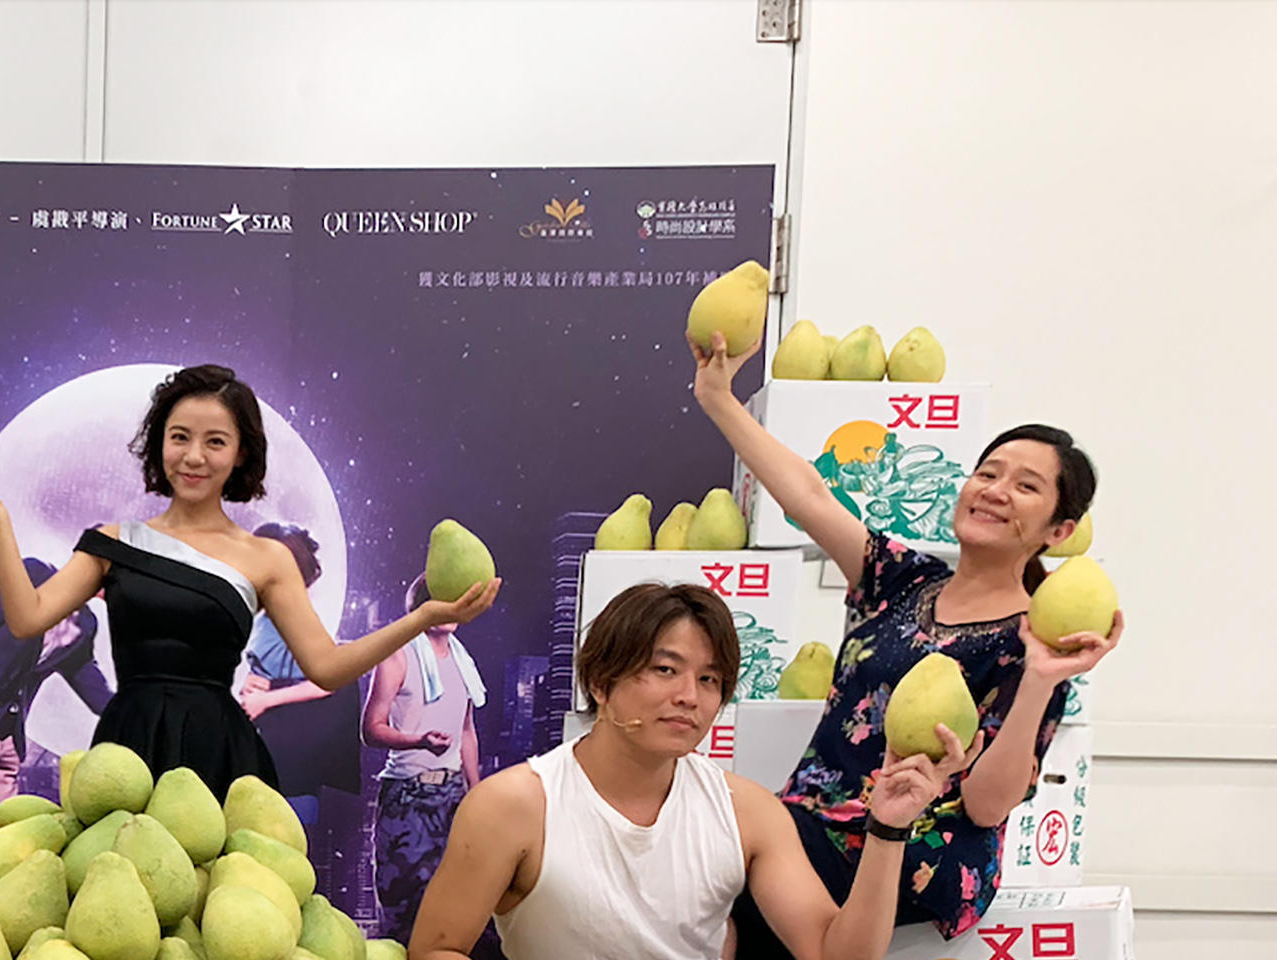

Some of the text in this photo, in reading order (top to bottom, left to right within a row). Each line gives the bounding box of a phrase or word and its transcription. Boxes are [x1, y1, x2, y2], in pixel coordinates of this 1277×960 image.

[151, 212, 292, 230] FORTUNE STAR
[323, 211, 473, 237] QUEEN SHOP
[418, 270, 726, 288] 獲文化部影視及流行音樂產業局107年補
[887, 394, 960, 429] 文旦
[701, 562, 770, 598] 文旦
[1016, 800, 1035, 867] 保証
